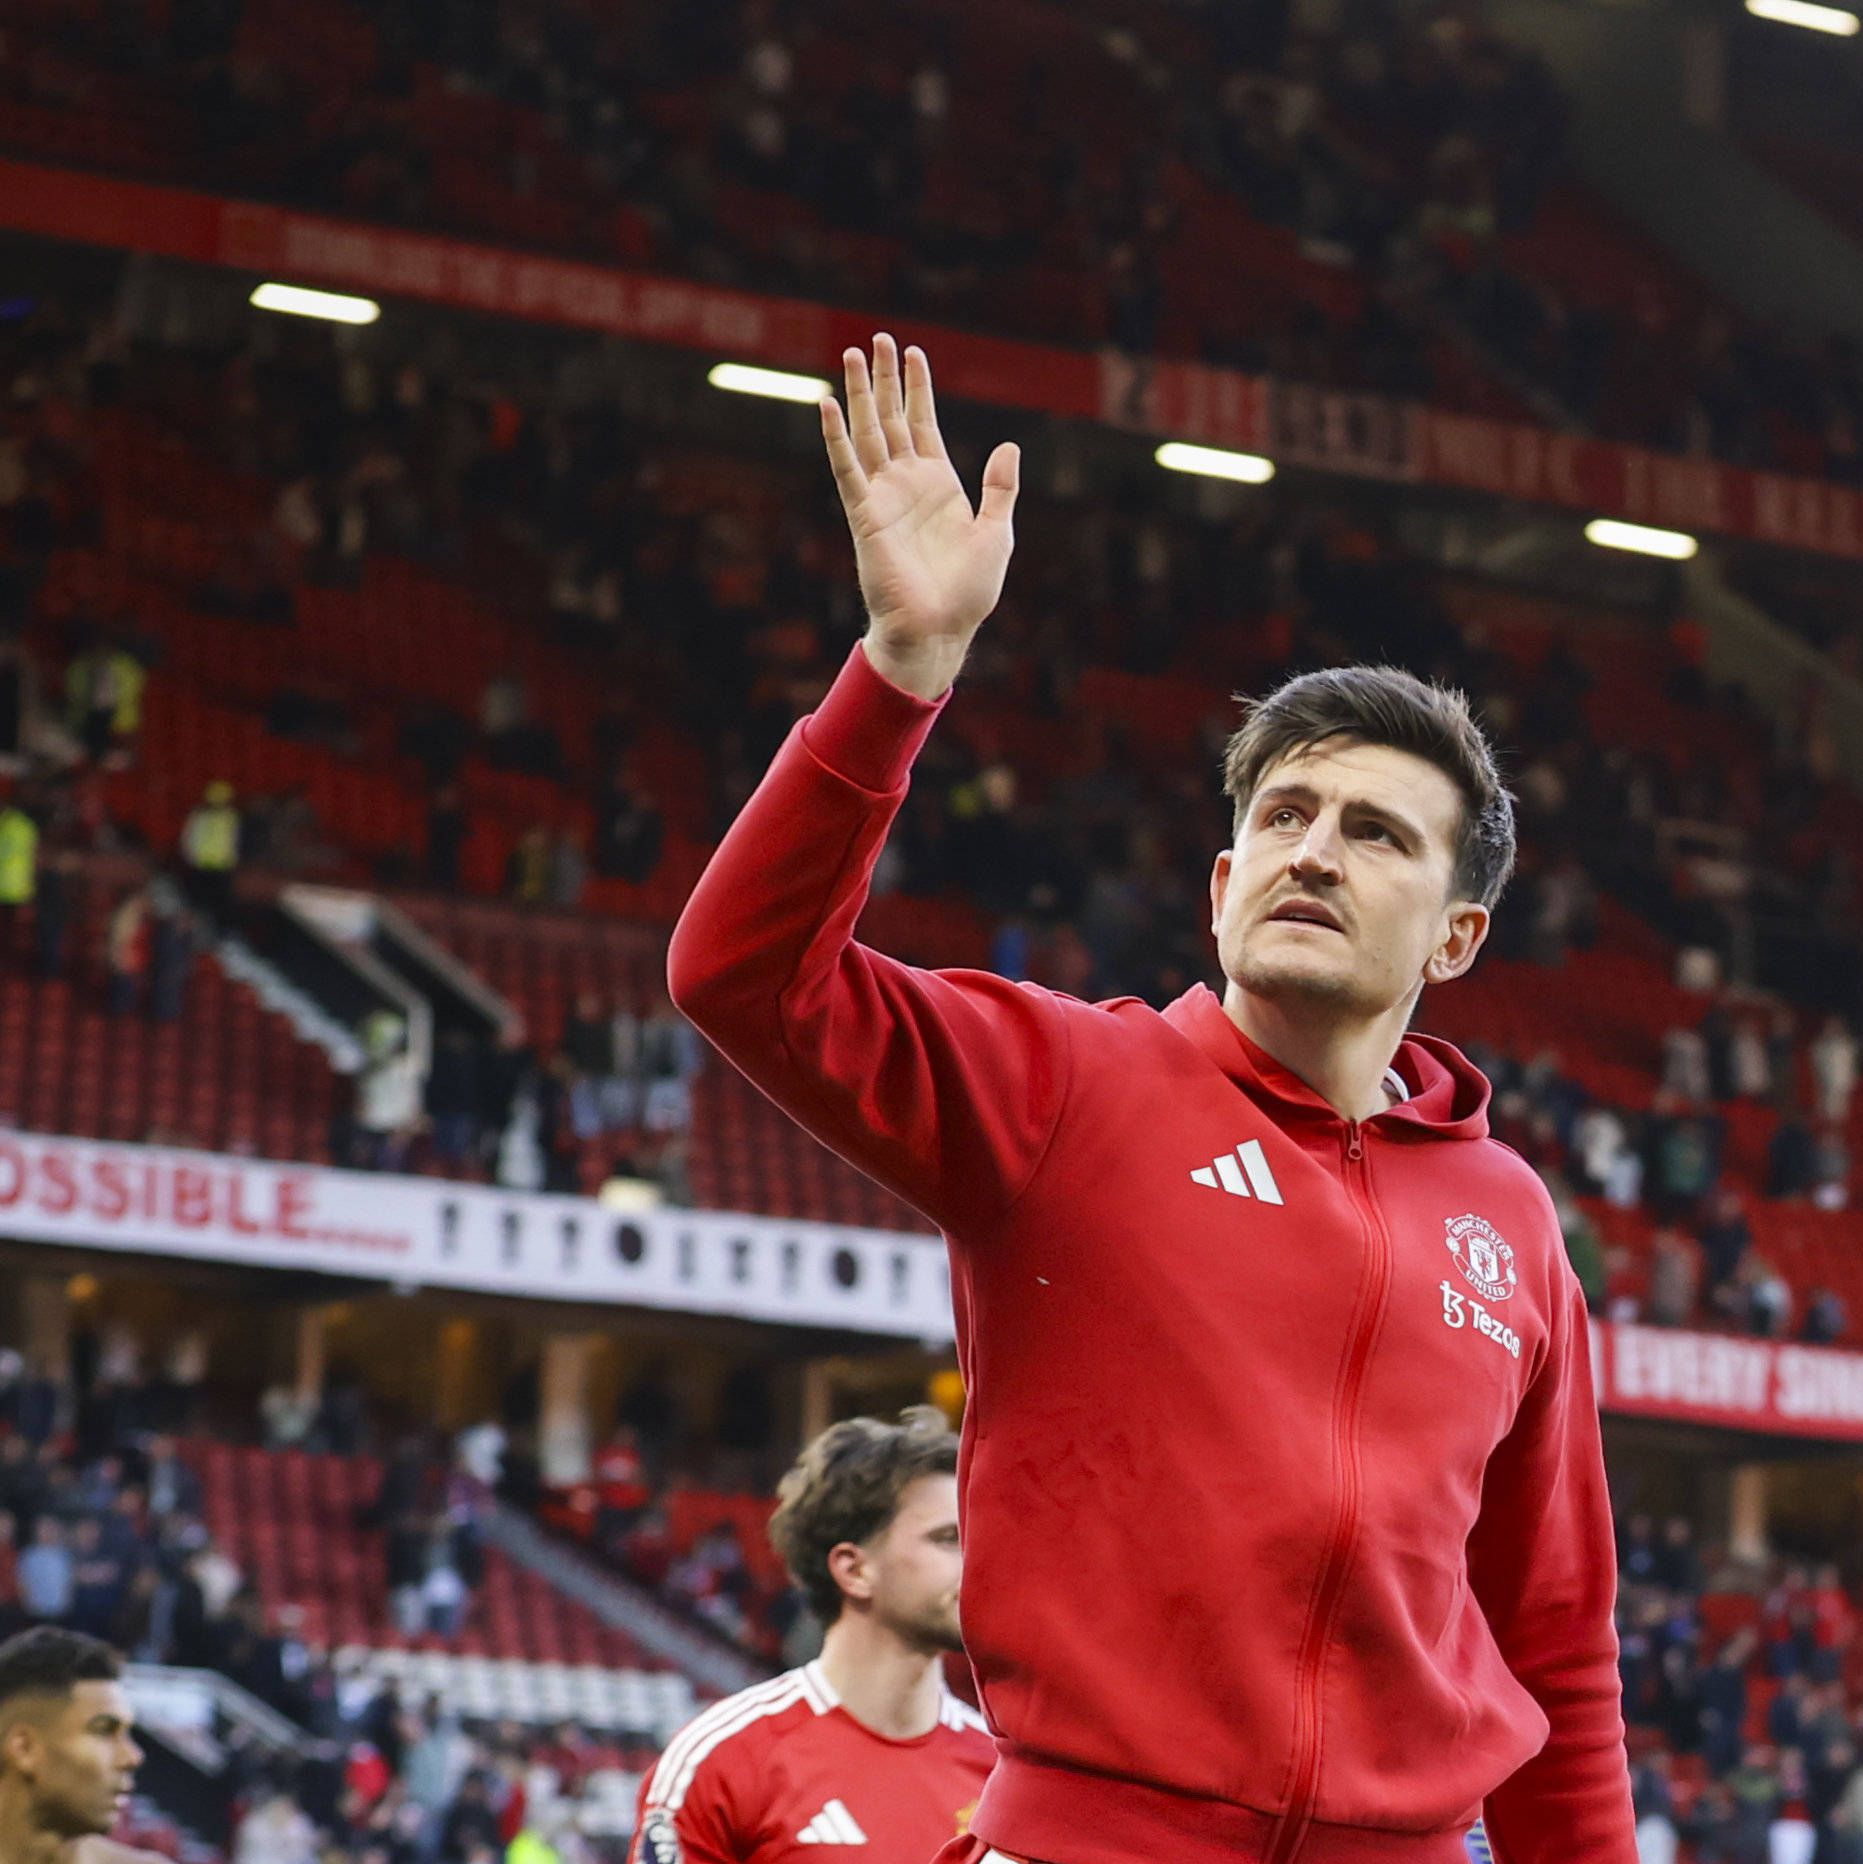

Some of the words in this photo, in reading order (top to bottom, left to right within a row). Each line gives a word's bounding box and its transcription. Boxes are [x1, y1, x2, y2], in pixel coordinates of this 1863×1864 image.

[1451, 1220, 1513, 1260] MANCHESTER
[1466, 1270, 1506, 1297] UNITED
[1468, 1300, 1520, 1358] Tezos
